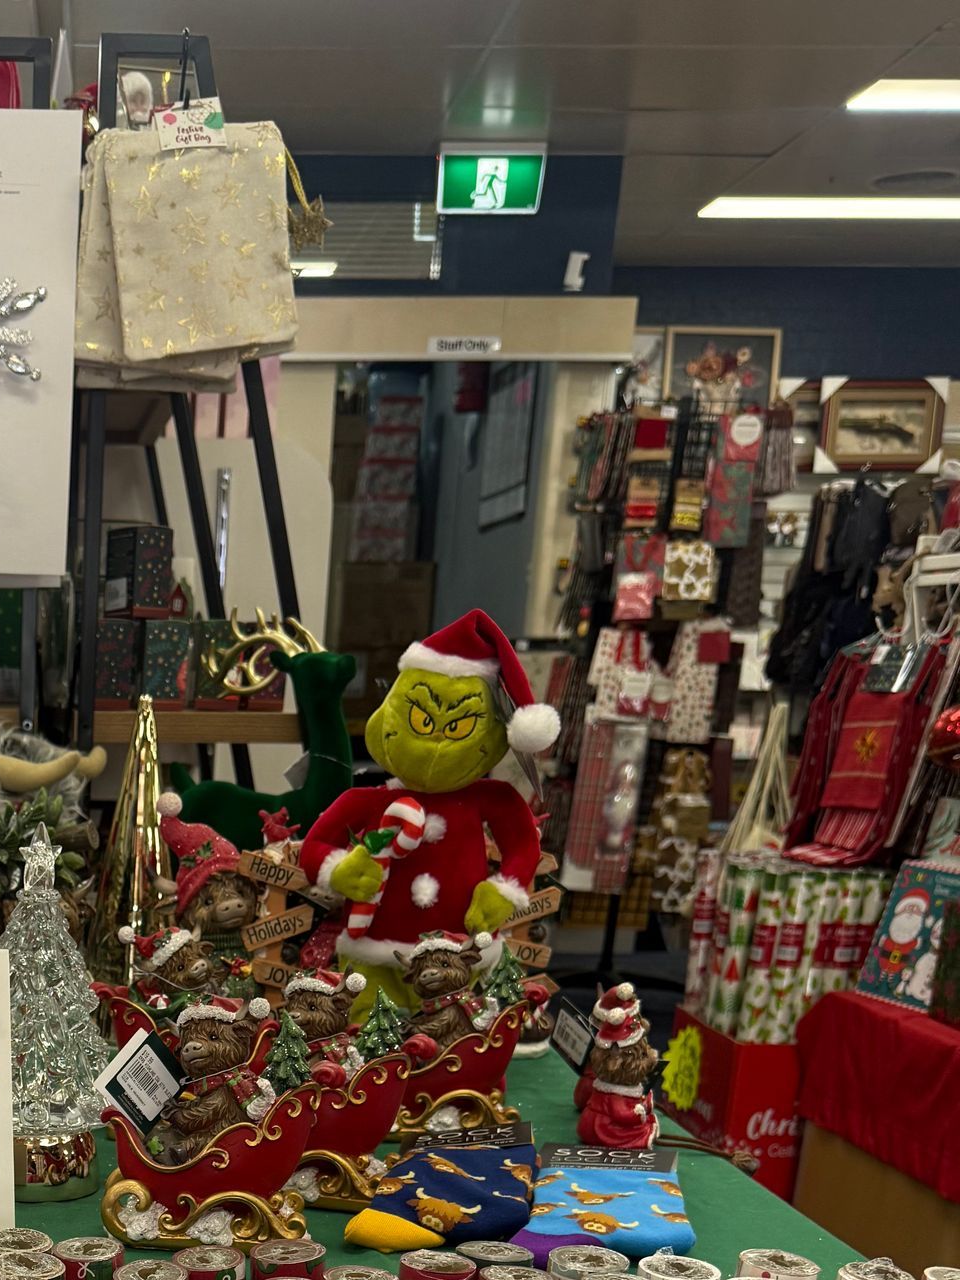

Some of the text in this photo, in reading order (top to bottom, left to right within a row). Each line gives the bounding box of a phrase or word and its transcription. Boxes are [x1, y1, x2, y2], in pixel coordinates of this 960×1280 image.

[177, 126, 203, 134] Festive
[176, 134, 211, 144] Gift Bag
[437, 340, 488, 353] Staff Only
[250, 855, 294, 887] Happy
[247, 914, 304, 944] Holidays
[515, 944, 540, 960] JOY
[265, 966, 291, 984] JOY
[414, 1133, 513, 1146] SOCIETY
[418, 1126, 513, 1141] SOCK
[551, 1156, 655, 1164] SOCIETY
[554, 1148, 657, 1159] SOCK
